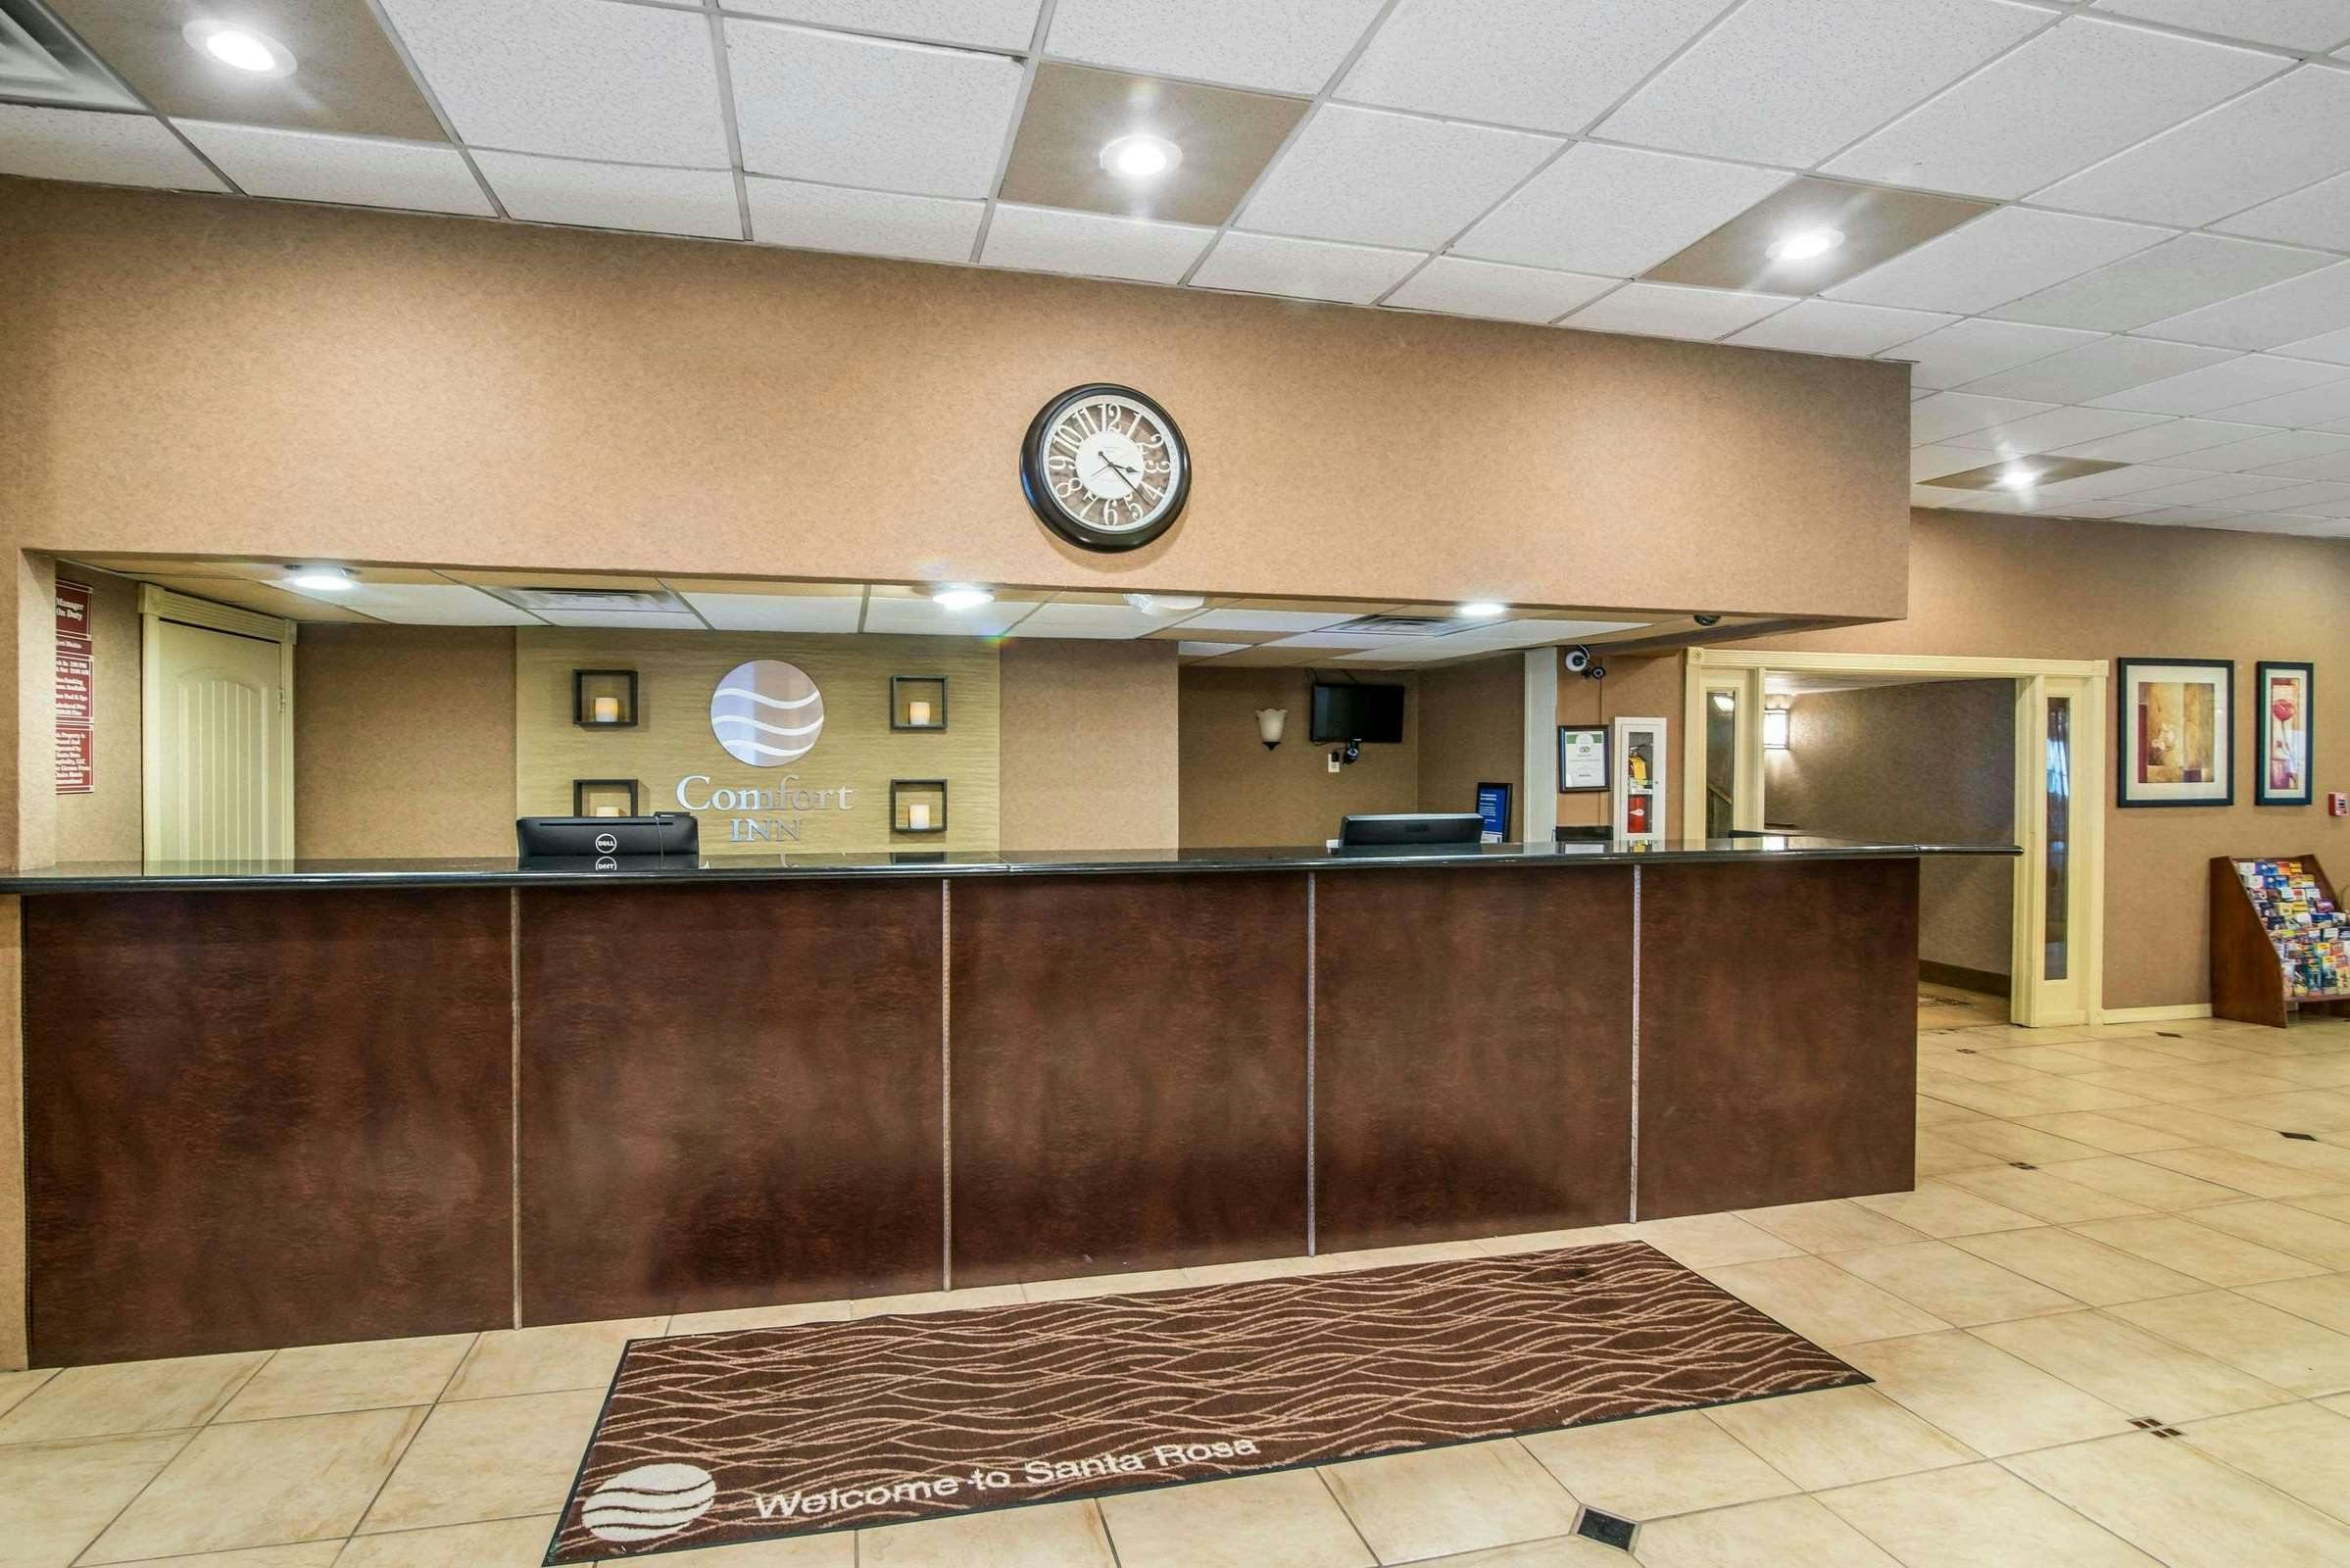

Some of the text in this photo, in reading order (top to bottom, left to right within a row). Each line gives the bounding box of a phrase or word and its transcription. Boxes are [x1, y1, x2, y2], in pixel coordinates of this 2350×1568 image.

[1098, 403, 1122, 432] 12
[1125, 412, 1143, 439] 1
[1136, 433, 1164, 456] 2
[1049, 455, 1076, 470] 9
[1144, 460, 1170, 473] 3
[1055, 477, 1083, 498] 8
[1141, 480, 1165, 500] 4
[1103, 499, 1119, 526] 6
[676, 773, 855, 811] Comfort
[729, 817, 802, 843] INN
[755, 1438, 1261, 1519] Welcome to Santa Rosa
